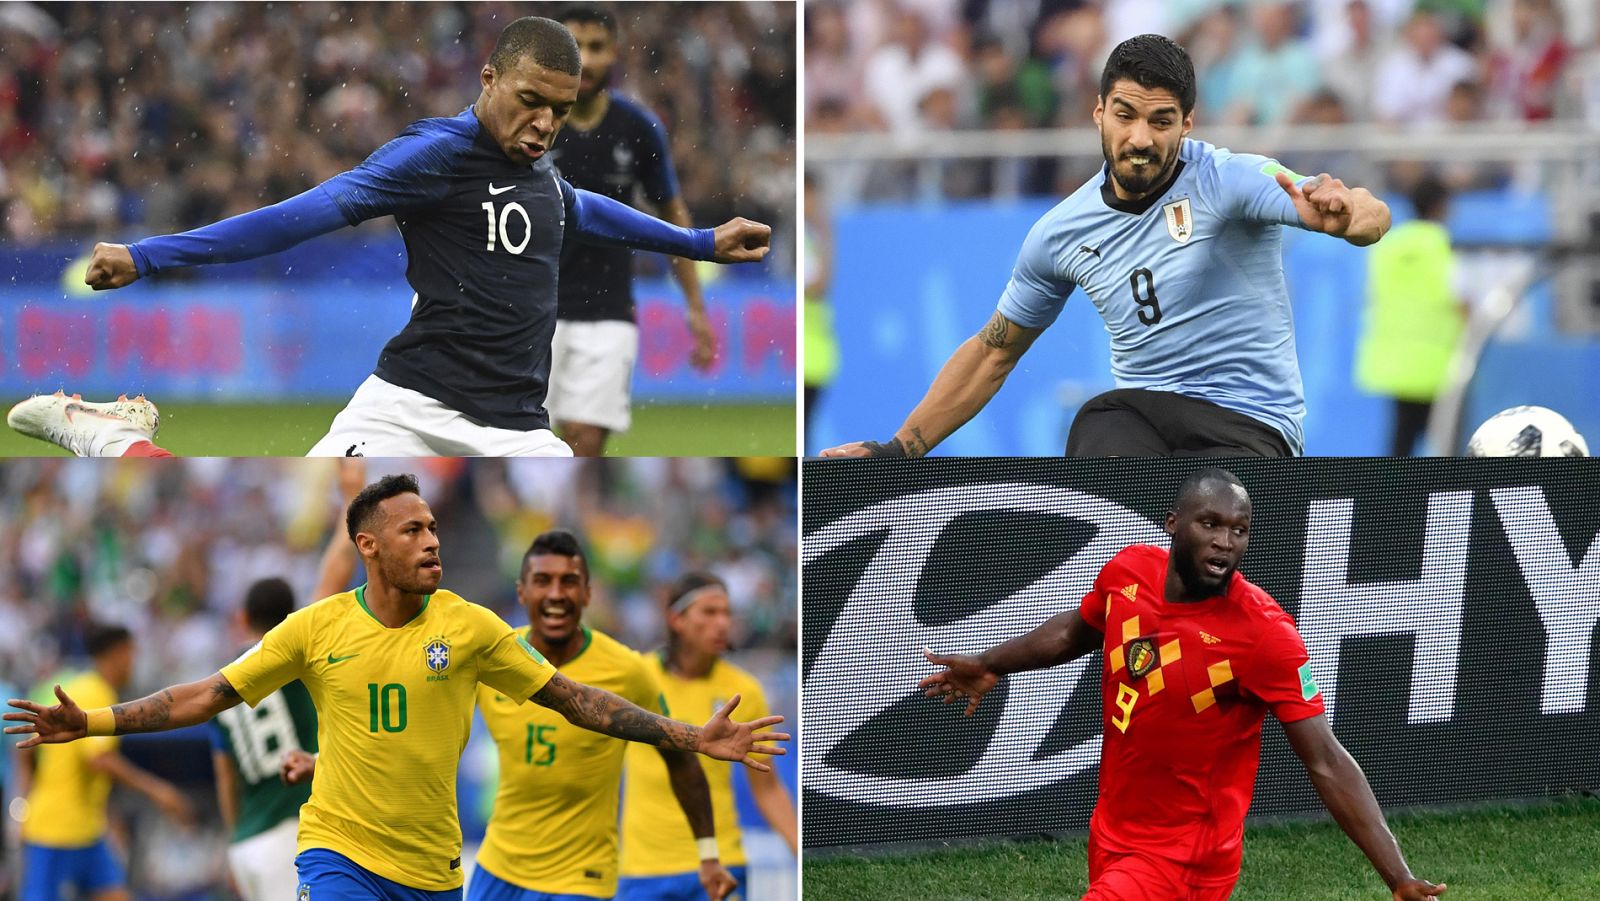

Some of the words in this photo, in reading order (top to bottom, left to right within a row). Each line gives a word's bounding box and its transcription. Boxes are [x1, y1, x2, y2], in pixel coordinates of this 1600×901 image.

[482, 202, 531, 254] 10
[1129, 267, 1162, 326] 9
[1297, 486, 1600, 729] HY
[368, 683, 407, 732] 10
[1112, 682, 1139, 734] 9
[218, 688, 301, 784] 18
[526, 723, 556, 766] 15
